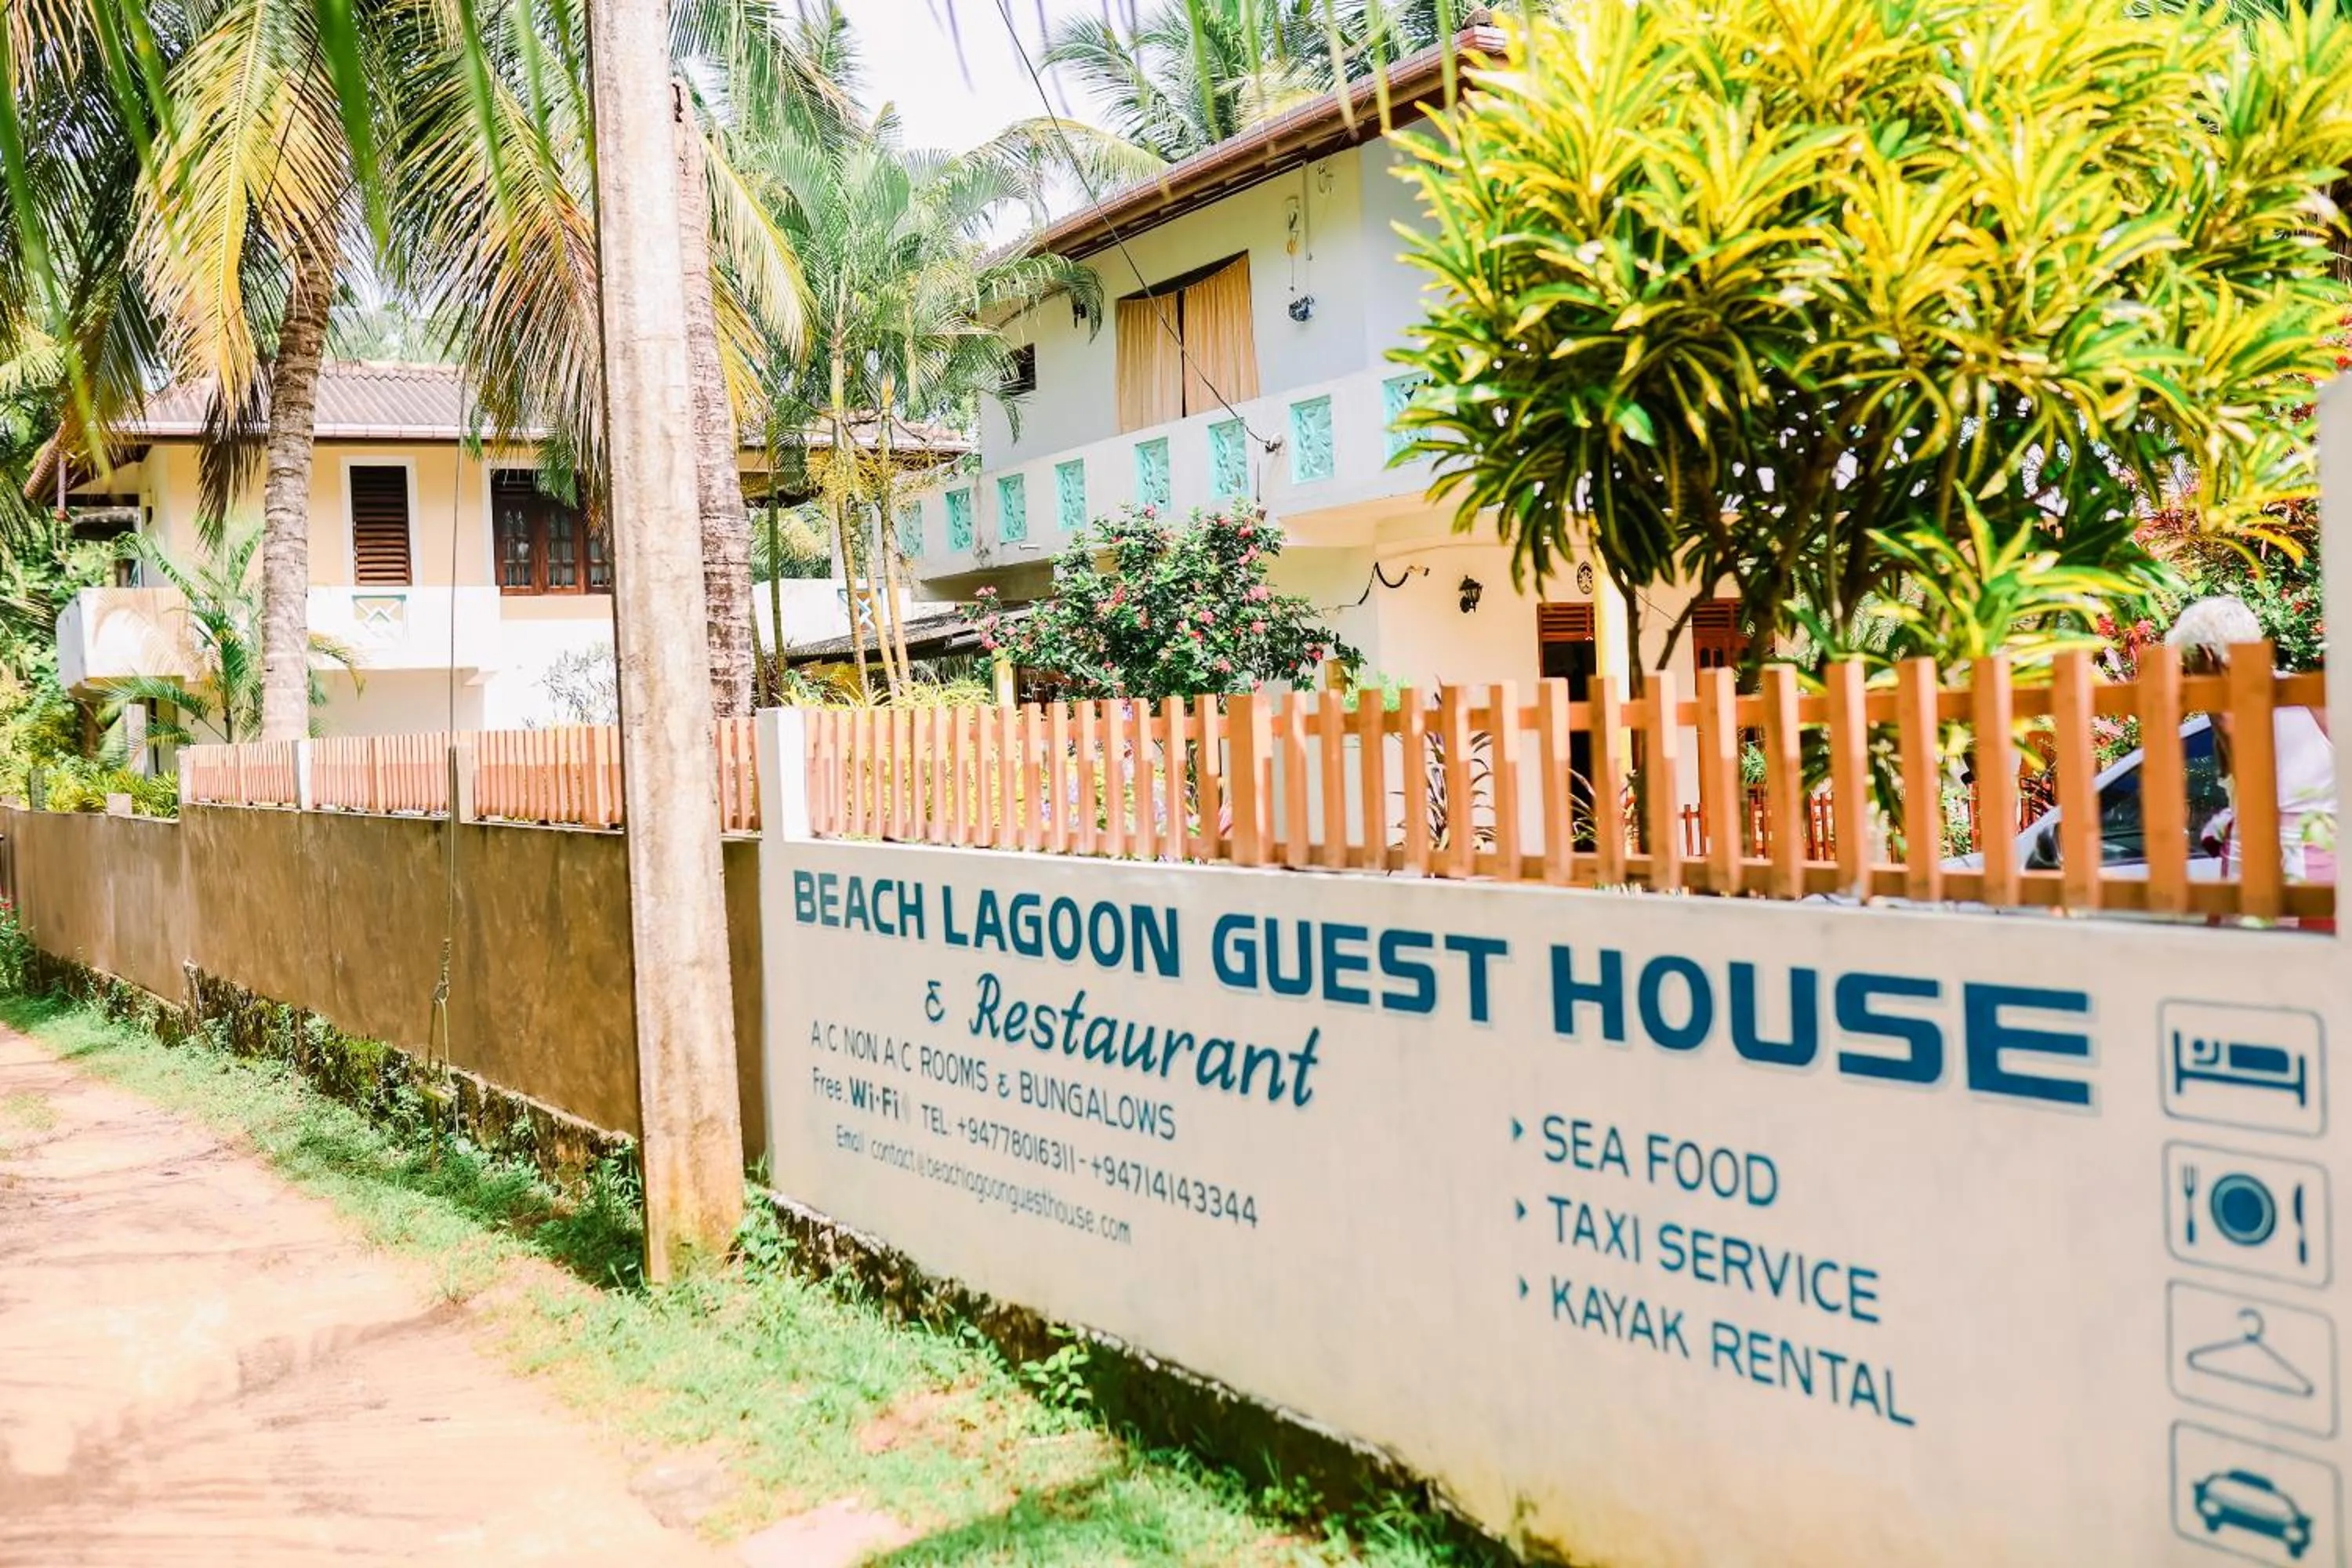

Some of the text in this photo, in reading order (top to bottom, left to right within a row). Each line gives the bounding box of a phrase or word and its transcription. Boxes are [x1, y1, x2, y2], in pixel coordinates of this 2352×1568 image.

[793, 870, 2092, 1107] BEACH LAGOON GUEST HOUSE
[925, 973, 1320, 1108] & Restaurant
[844, 1025, 877, 1063] NON
[920, 1046, 989, 1092] ROOMS
[996, 1072, 1011, 1098] &
[1020, 1071, 1176, 1141] BUNGALOWS
[848, 1076, 898, 1120] Wi-Fi
[1543, 1115, 1780, 1207] SEA FOOD
[1546, 1194, 1880, 1325] TAXI SERVICE
[1550, 1275, 1916, 1428] KAYAK RENTAL
